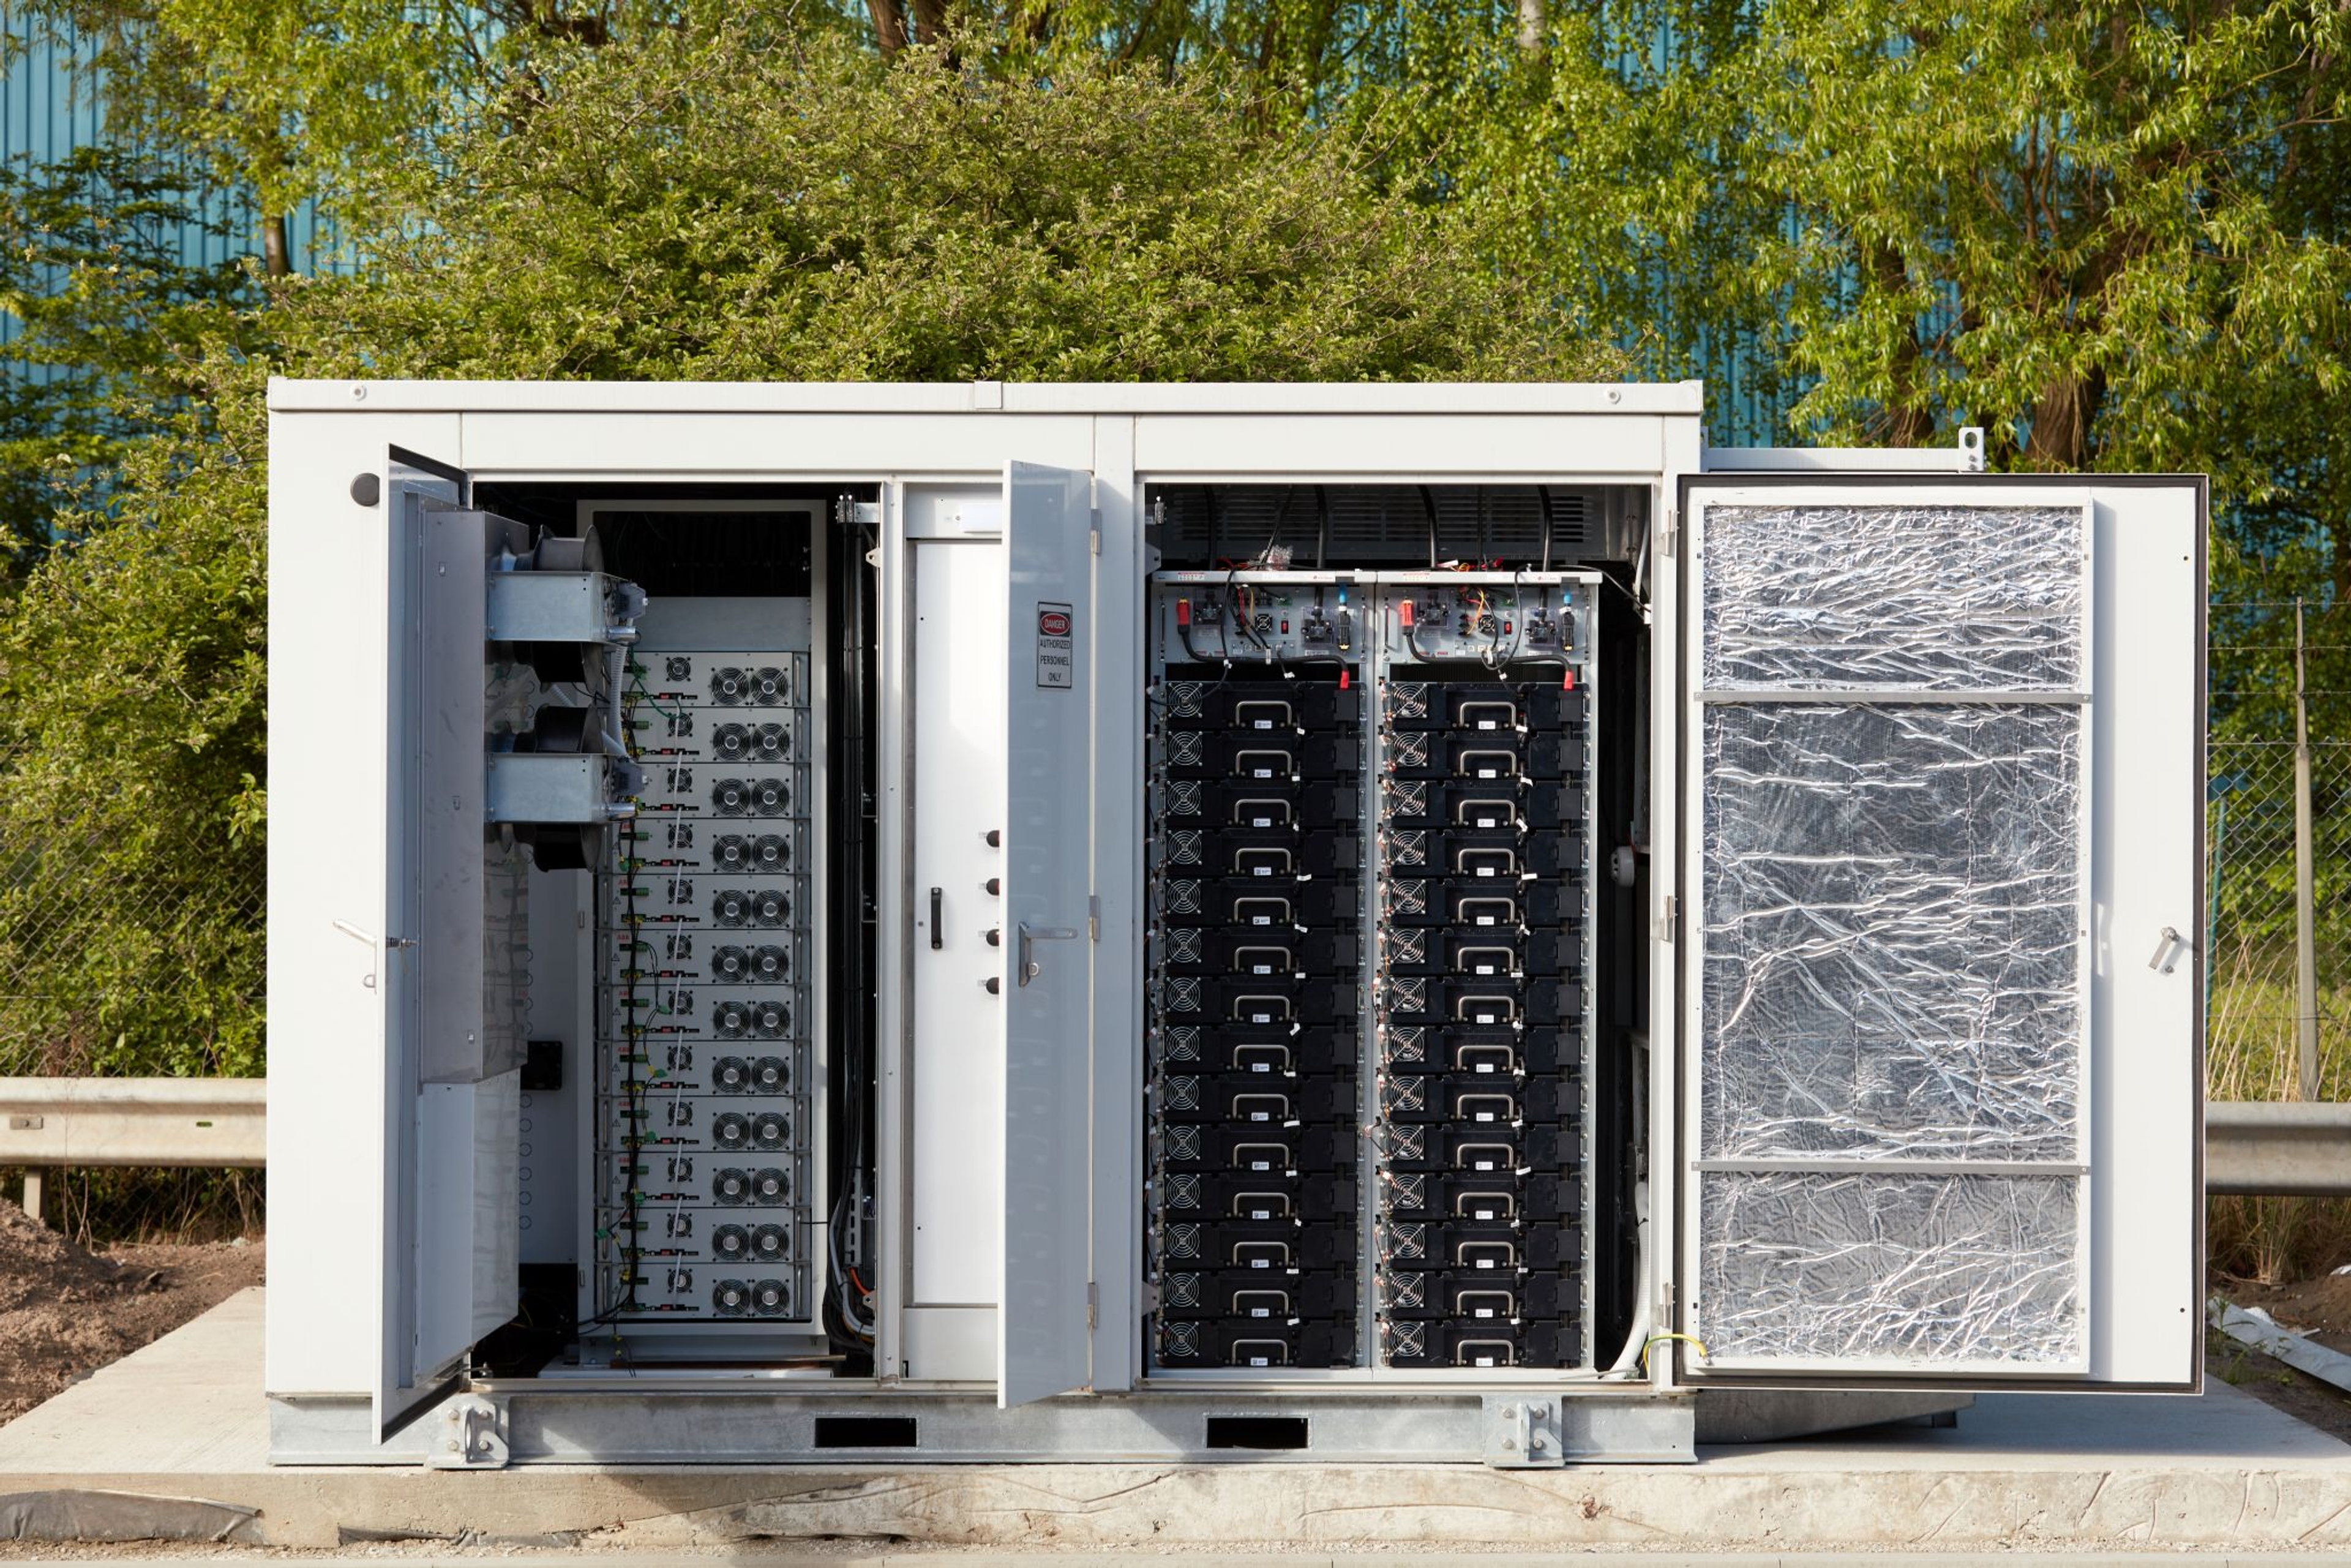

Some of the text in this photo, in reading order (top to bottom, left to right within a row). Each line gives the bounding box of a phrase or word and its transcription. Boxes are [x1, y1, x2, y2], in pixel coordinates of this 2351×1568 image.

[1044, 618, 1065, 629] DANGER
[1040, 639, 1071, 649] AUTHORIZED
[1040, 655, 1070, 666] PERSONNEL
[1048, 672, 1062, 681] ONLY
